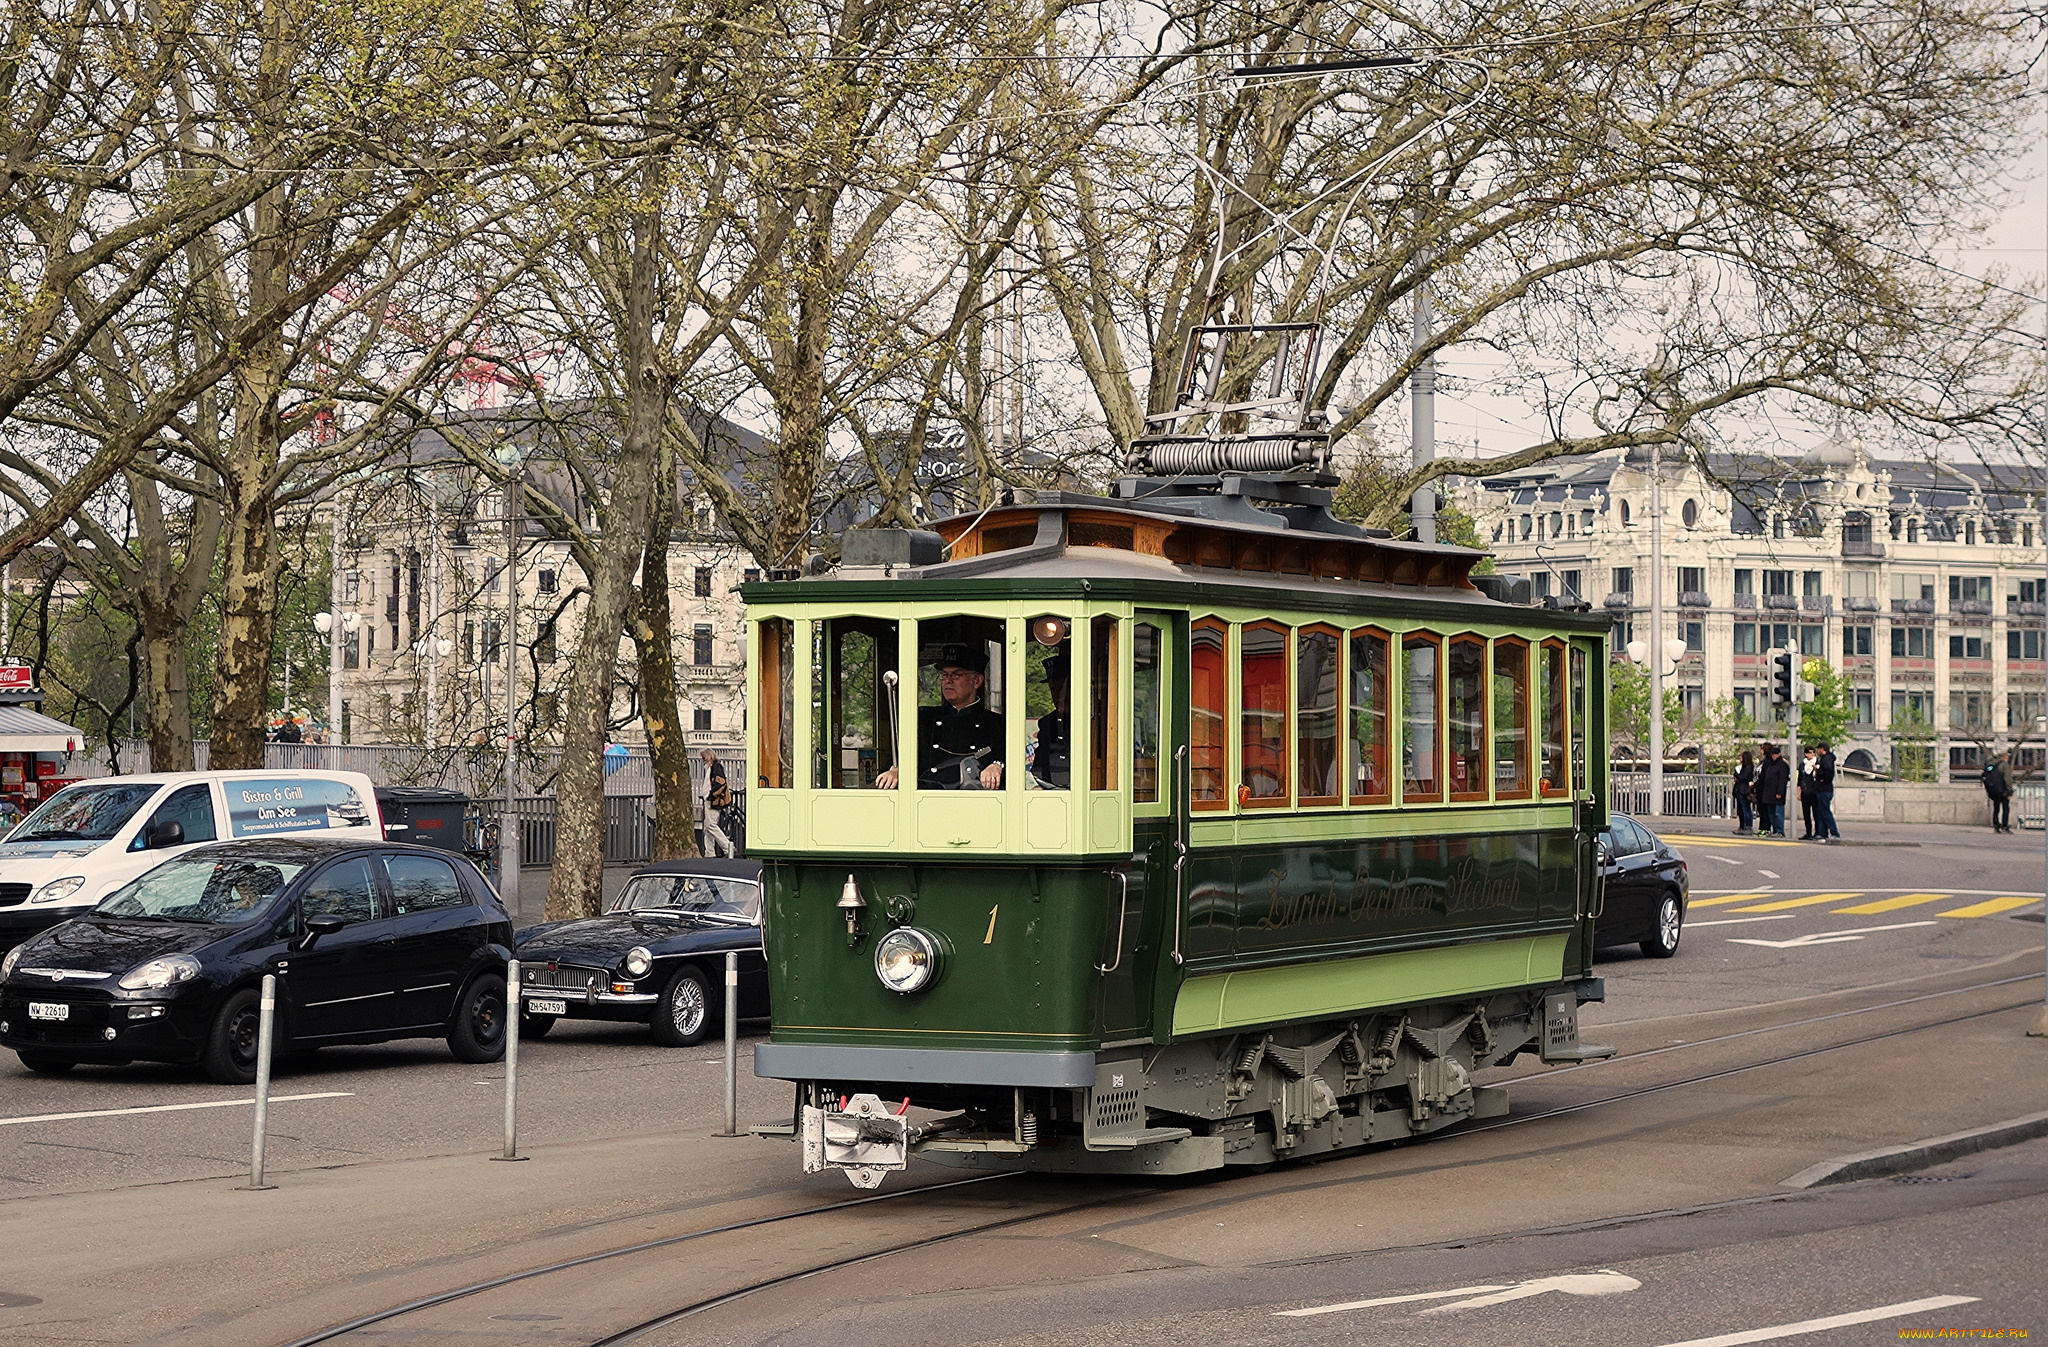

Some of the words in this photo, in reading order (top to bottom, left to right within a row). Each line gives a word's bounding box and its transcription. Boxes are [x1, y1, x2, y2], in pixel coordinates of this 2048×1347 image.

[242, 789, 272, 803] Bistro
[273, 787, 282, 801] &
[284, 786, 303, 800] Grill
[258, 806, 276, 820] Am
[276, 804, 297, 818] See
[983, 904, 999, 944] 1
